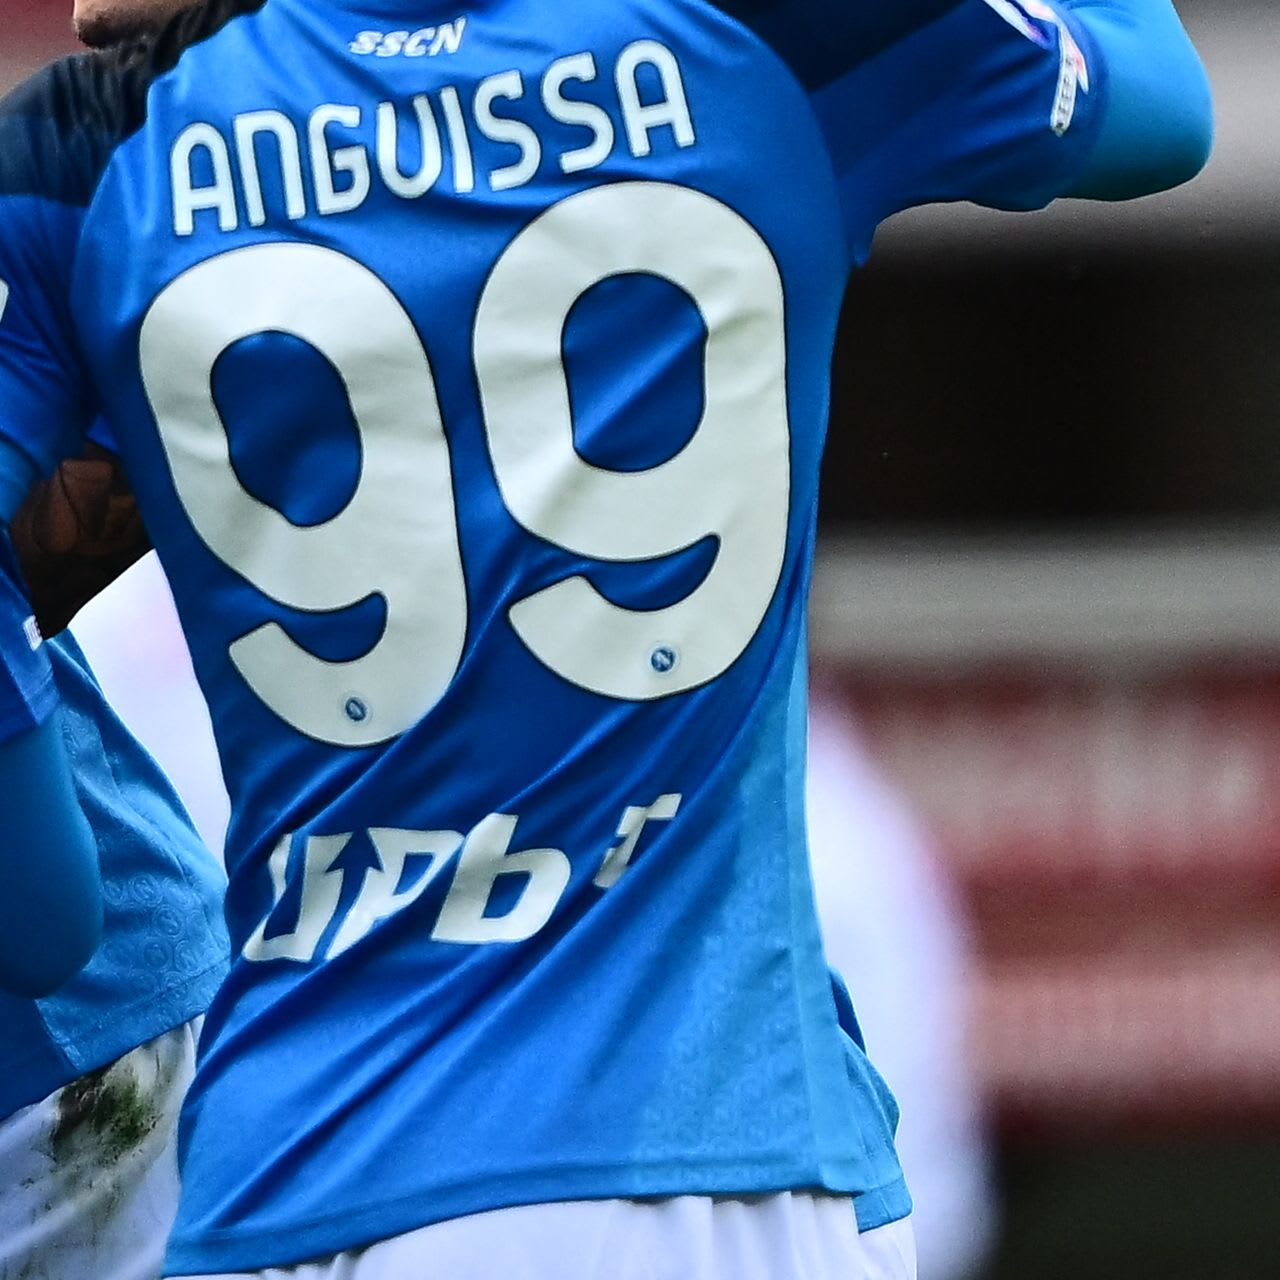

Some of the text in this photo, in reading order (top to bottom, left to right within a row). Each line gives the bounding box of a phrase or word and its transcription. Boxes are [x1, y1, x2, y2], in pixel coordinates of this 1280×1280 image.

[348, 16, 468, 59] SSCN
[171, 38, 698, 238] ANGUISSA
[137, 180, 792, 748] 99
